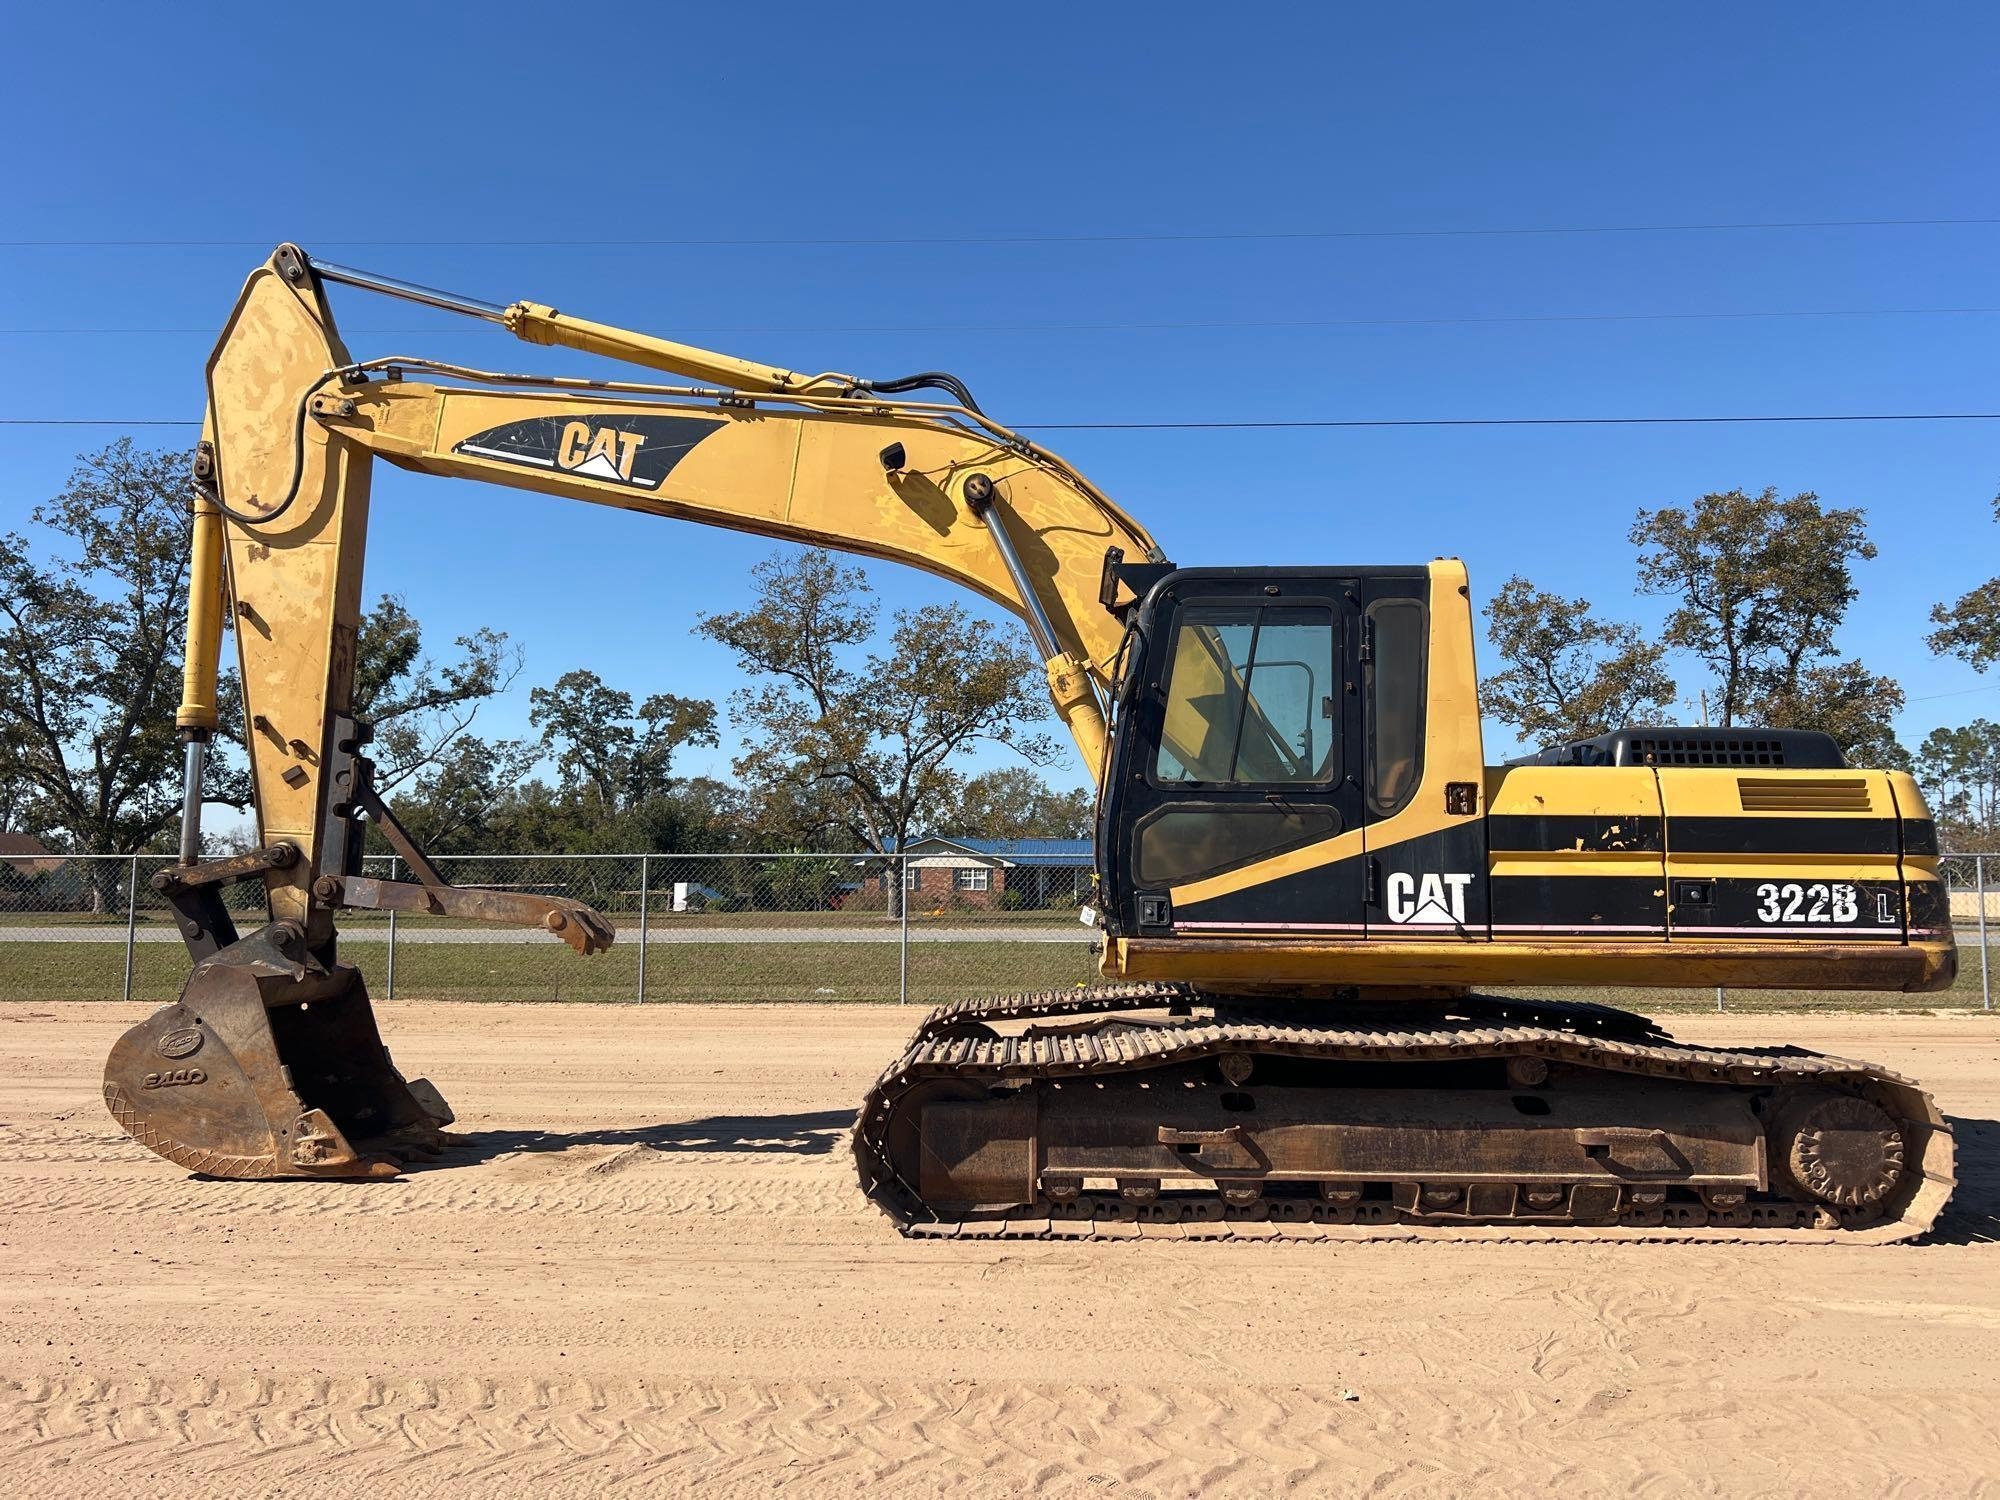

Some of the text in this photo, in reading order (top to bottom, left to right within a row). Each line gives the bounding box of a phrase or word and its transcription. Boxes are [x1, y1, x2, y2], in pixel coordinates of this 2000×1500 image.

[558, 421, 646, 481] CAT
[1387, 872, 1472, 924] CAT
[1757, 883, 1896, 923] 322B L
